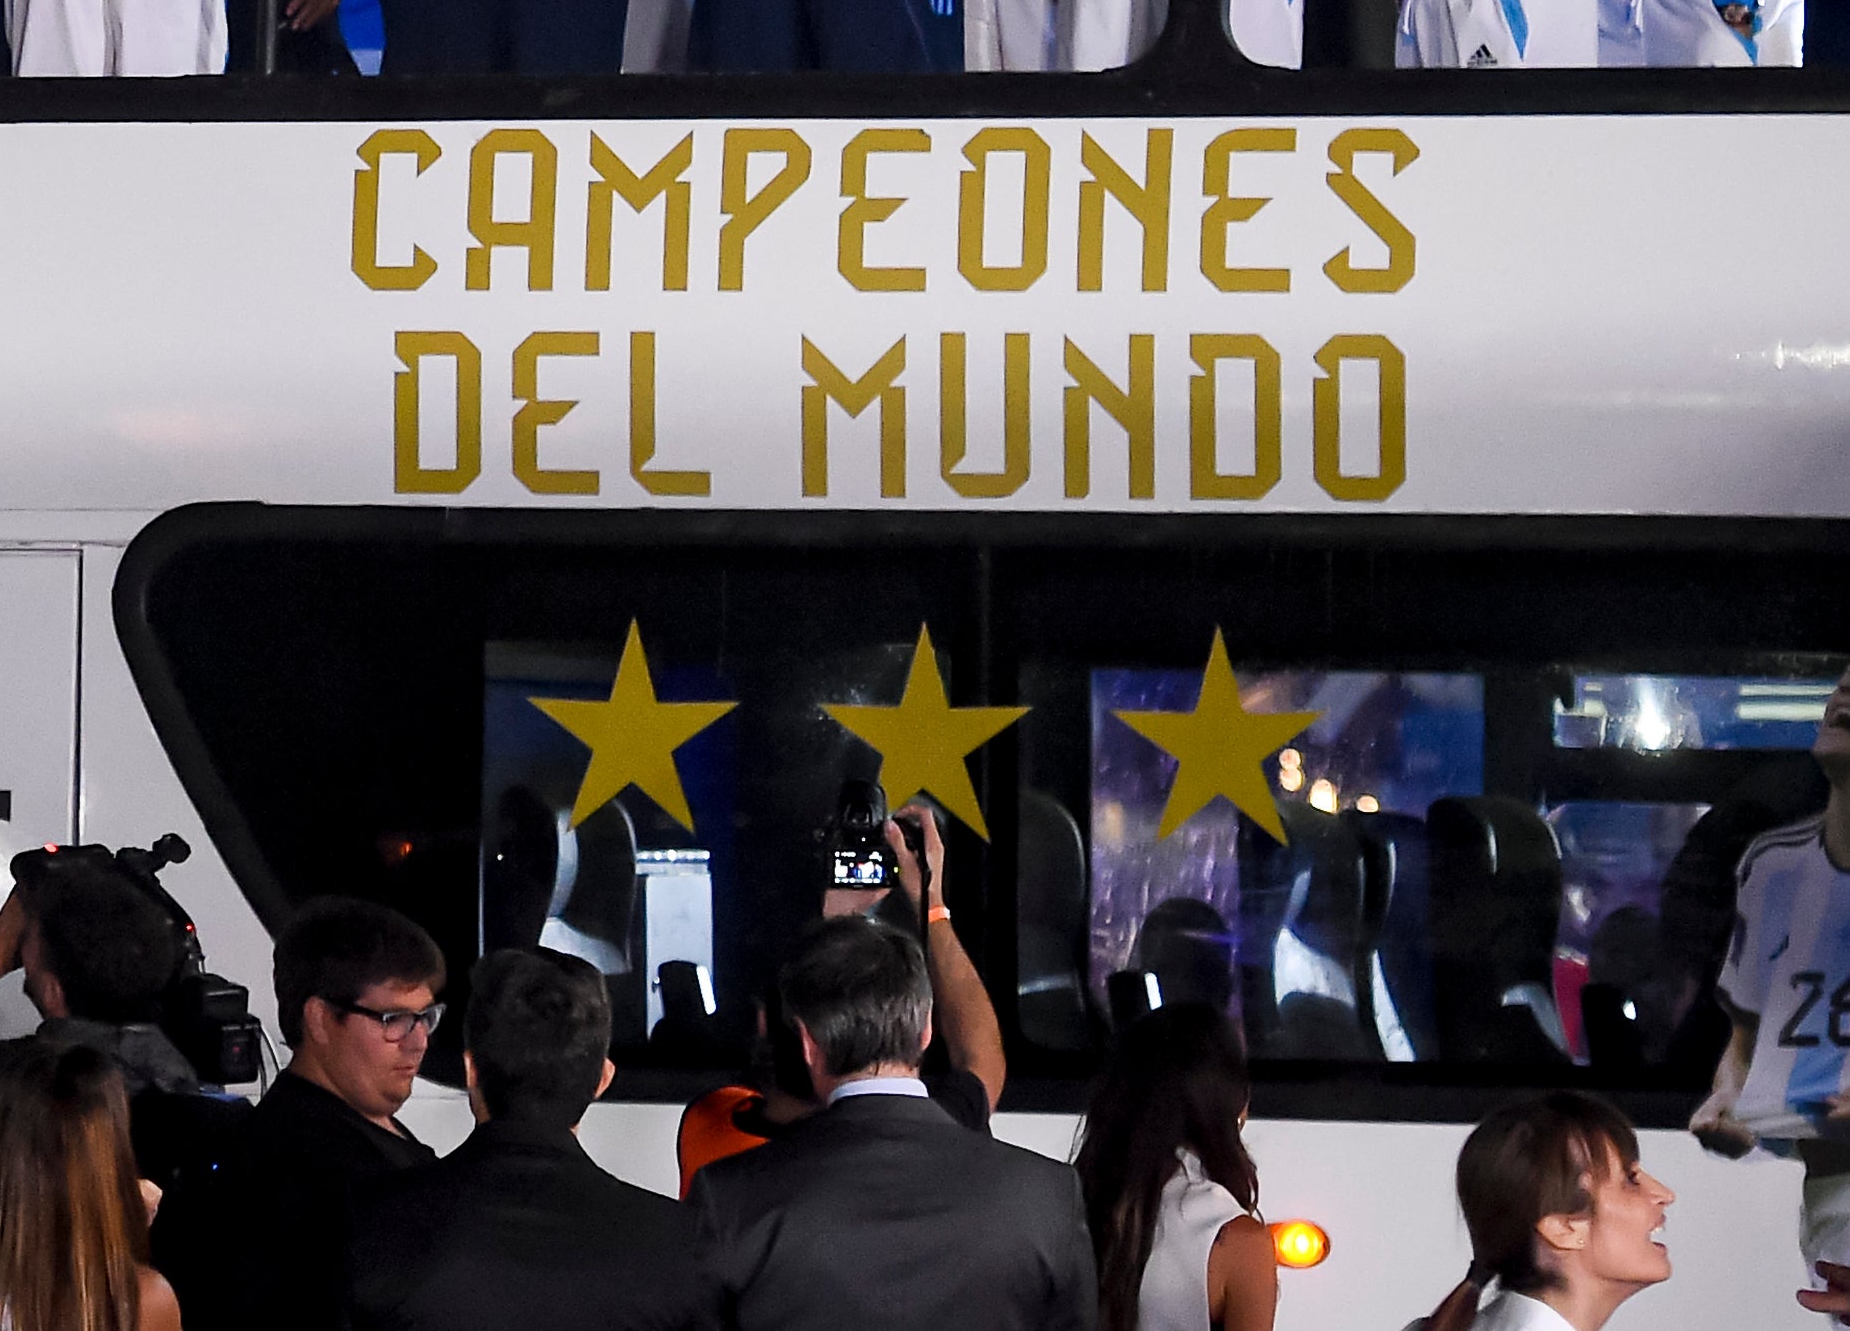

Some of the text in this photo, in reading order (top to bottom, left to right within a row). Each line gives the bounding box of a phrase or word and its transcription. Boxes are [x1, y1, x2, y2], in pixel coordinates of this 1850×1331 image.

[351, 127, 1419, 293] CAMPEONES
[393, 331, 1407, 502] DEL MUNDO
